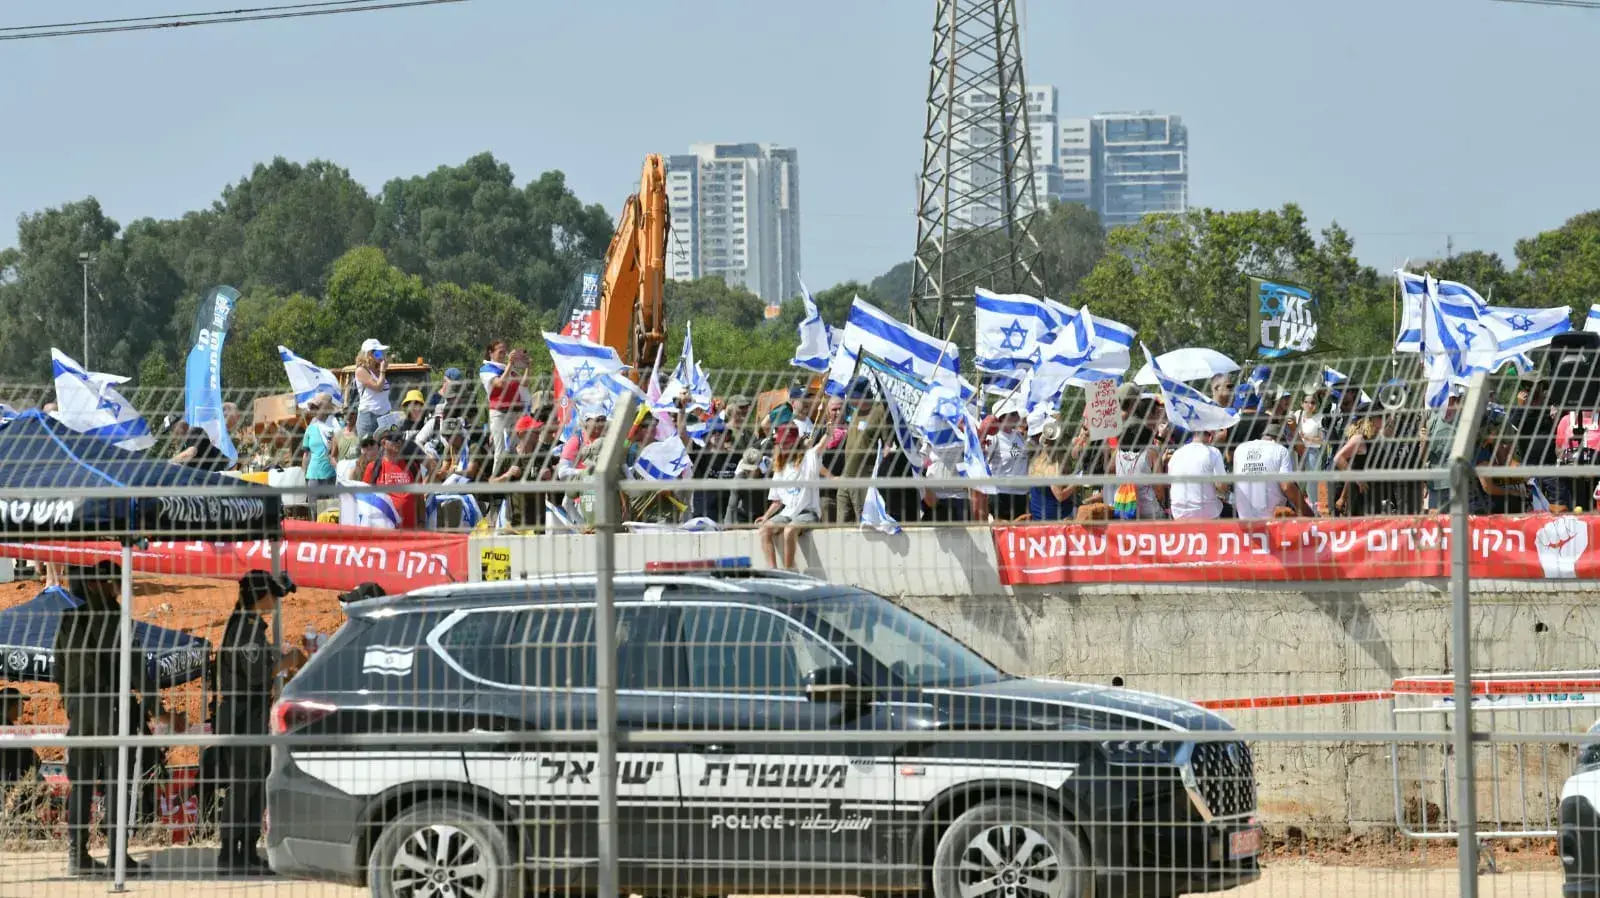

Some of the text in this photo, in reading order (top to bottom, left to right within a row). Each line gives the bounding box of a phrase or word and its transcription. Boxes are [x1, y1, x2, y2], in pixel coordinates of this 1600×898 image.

[1008, 532, 1107, 559] עצמאי!
[1117, 532, 1208, 556] משפט
[1217, 532, 1271, 555] בית
[1303, 525, 1356, 553] שלי
[1473, 528, 1525, 557] הקו
[297, 542, 386, 569] האדום
[397, 548, 449, 578] הקו
[541, 757, 849, 788] משטרת ישאל
[711, 814, 785, 830] POLICE
[801, 813, 873, 833] الشرطة
